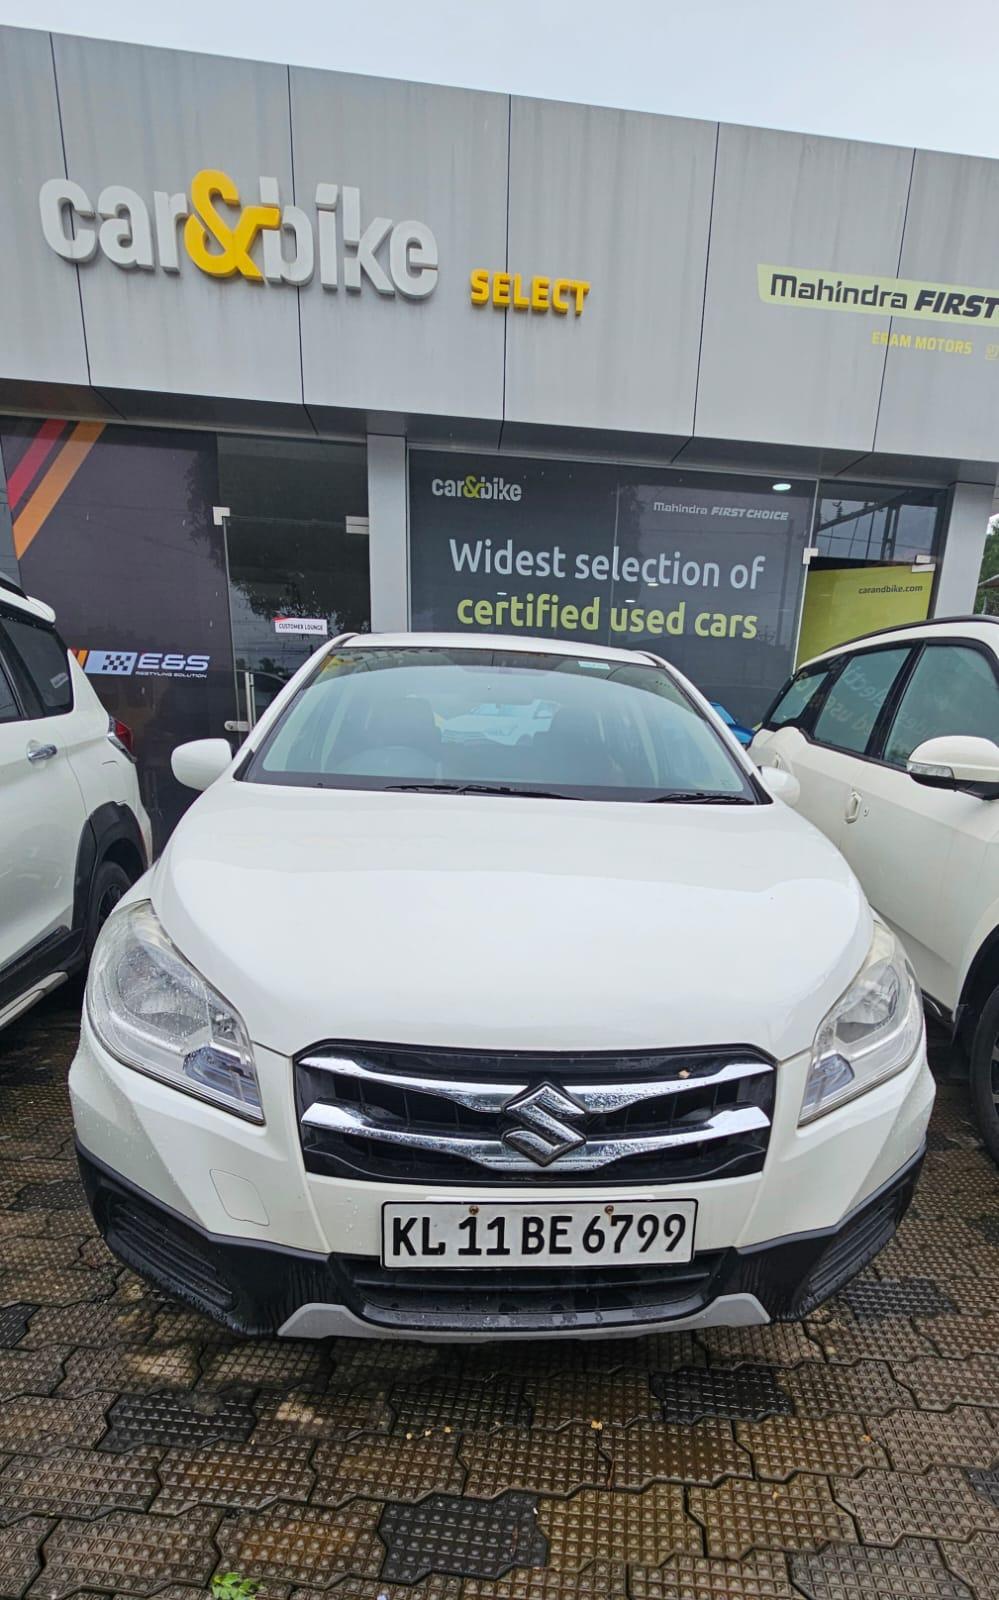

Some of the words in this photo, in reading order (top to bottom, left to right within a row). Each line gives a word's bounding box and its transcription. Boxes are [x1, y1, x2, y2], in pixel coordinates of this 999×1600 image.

[39, 168, 439, 298] car&bike
[470, 268, 591, 317] SELECT
[770, 273, 908, 309] Mahindra
[914, 289, 999, 319] FIRST
[871, 331, 912, 348] ERAM
[915, 336, 973, 355] MOTORS
[431, 475, 522, 501] car&bike
[653, 501, 708, 515] Mahindra
[711, 506, 746, 518] FIRST
[746, 508, 789, 521] CHOICE
[449, 538, 566, 578] Widest
[574, 546, 720, 587] selection
[730, 555, 766, 590] of
[858, 584, 923, 595] carandbike.com
[457, 593, 600, 631] certified
[610, 602, 685, 636] used
[694, 611, 757, 640] cars
[137, 652, 210, 671] E&S
[392, 1216, 446, 1256] KL
[458, 1216, 511, 1256] 11
[521, 1215, 573, 1255] BE
[582, 1213, 687, 1254] 6799
